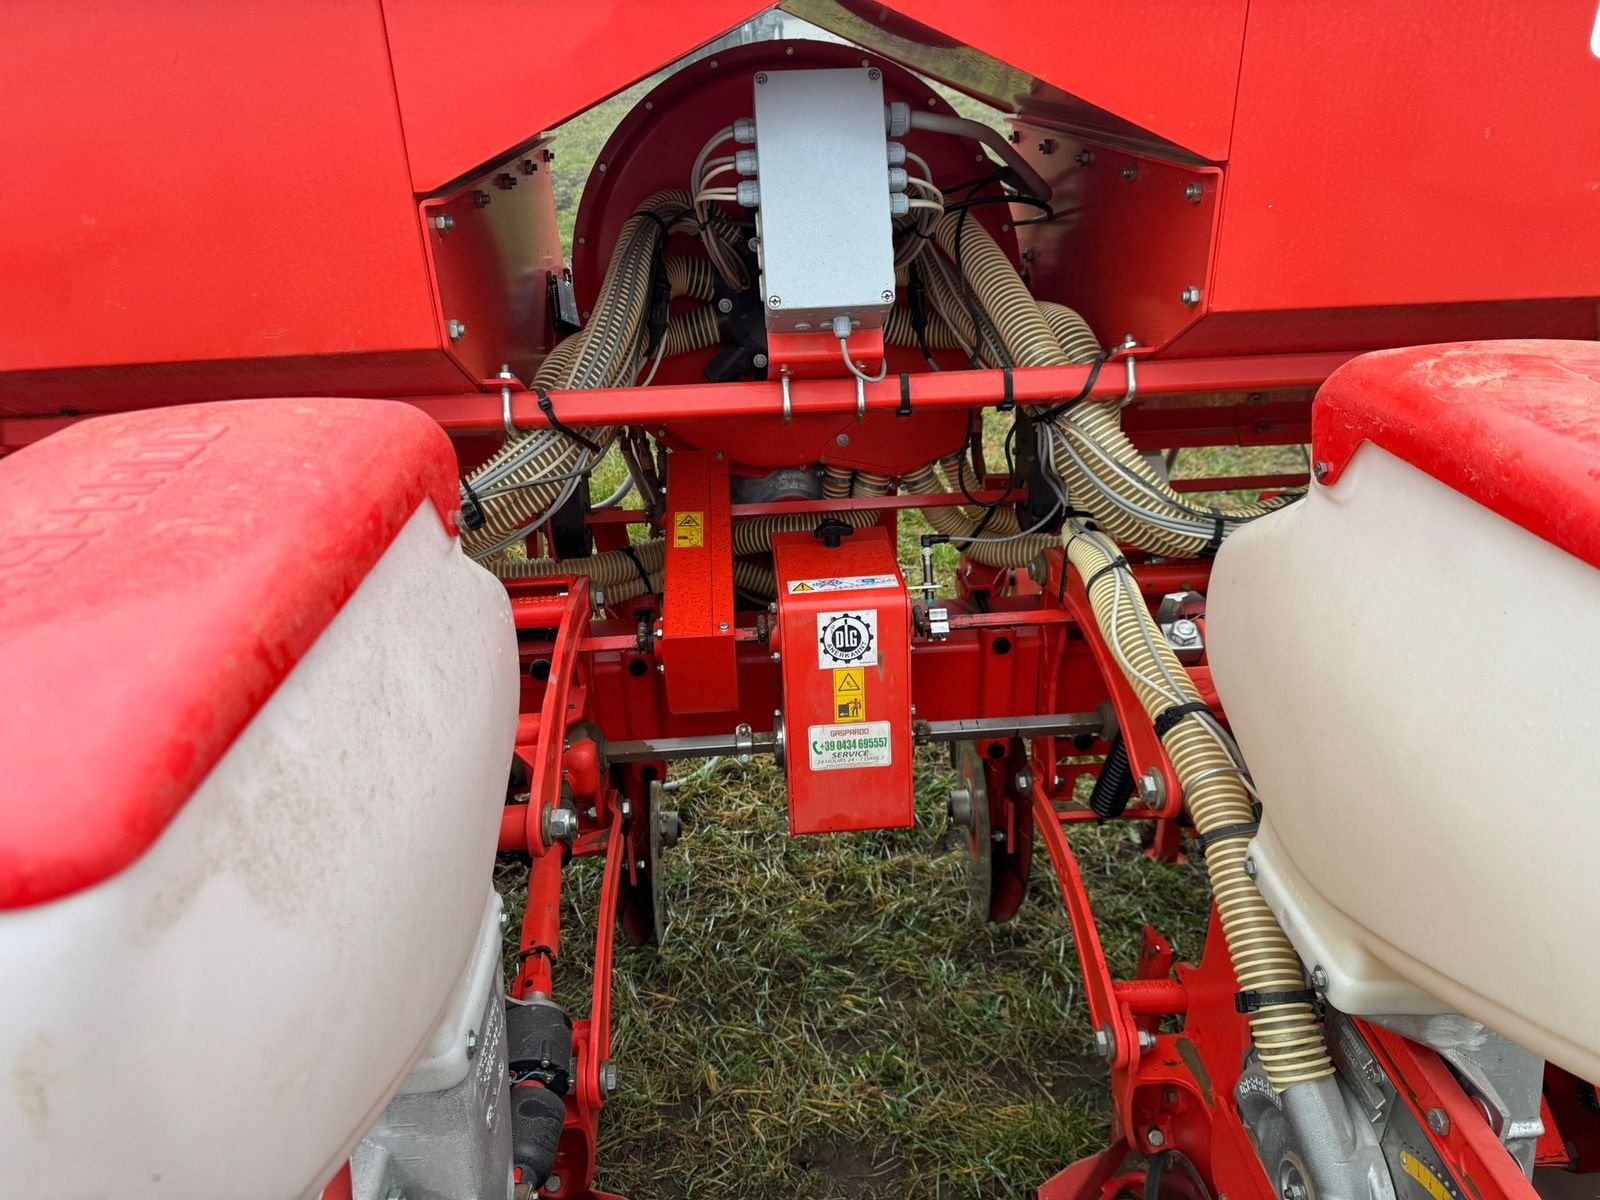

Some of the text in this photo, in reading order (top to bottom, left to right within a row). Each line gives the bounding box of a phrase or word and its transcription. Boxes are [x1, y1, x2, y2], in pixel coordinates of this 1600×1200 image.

[835, 619, 858, 648] DLG
[827, 641, 867, 658] ANERKANNT
[830, 728, 869, 737] GASPARDO
[820, 737, 887, 751] +39 0434 695557
[832, 750, 869, 758] SERVICE
